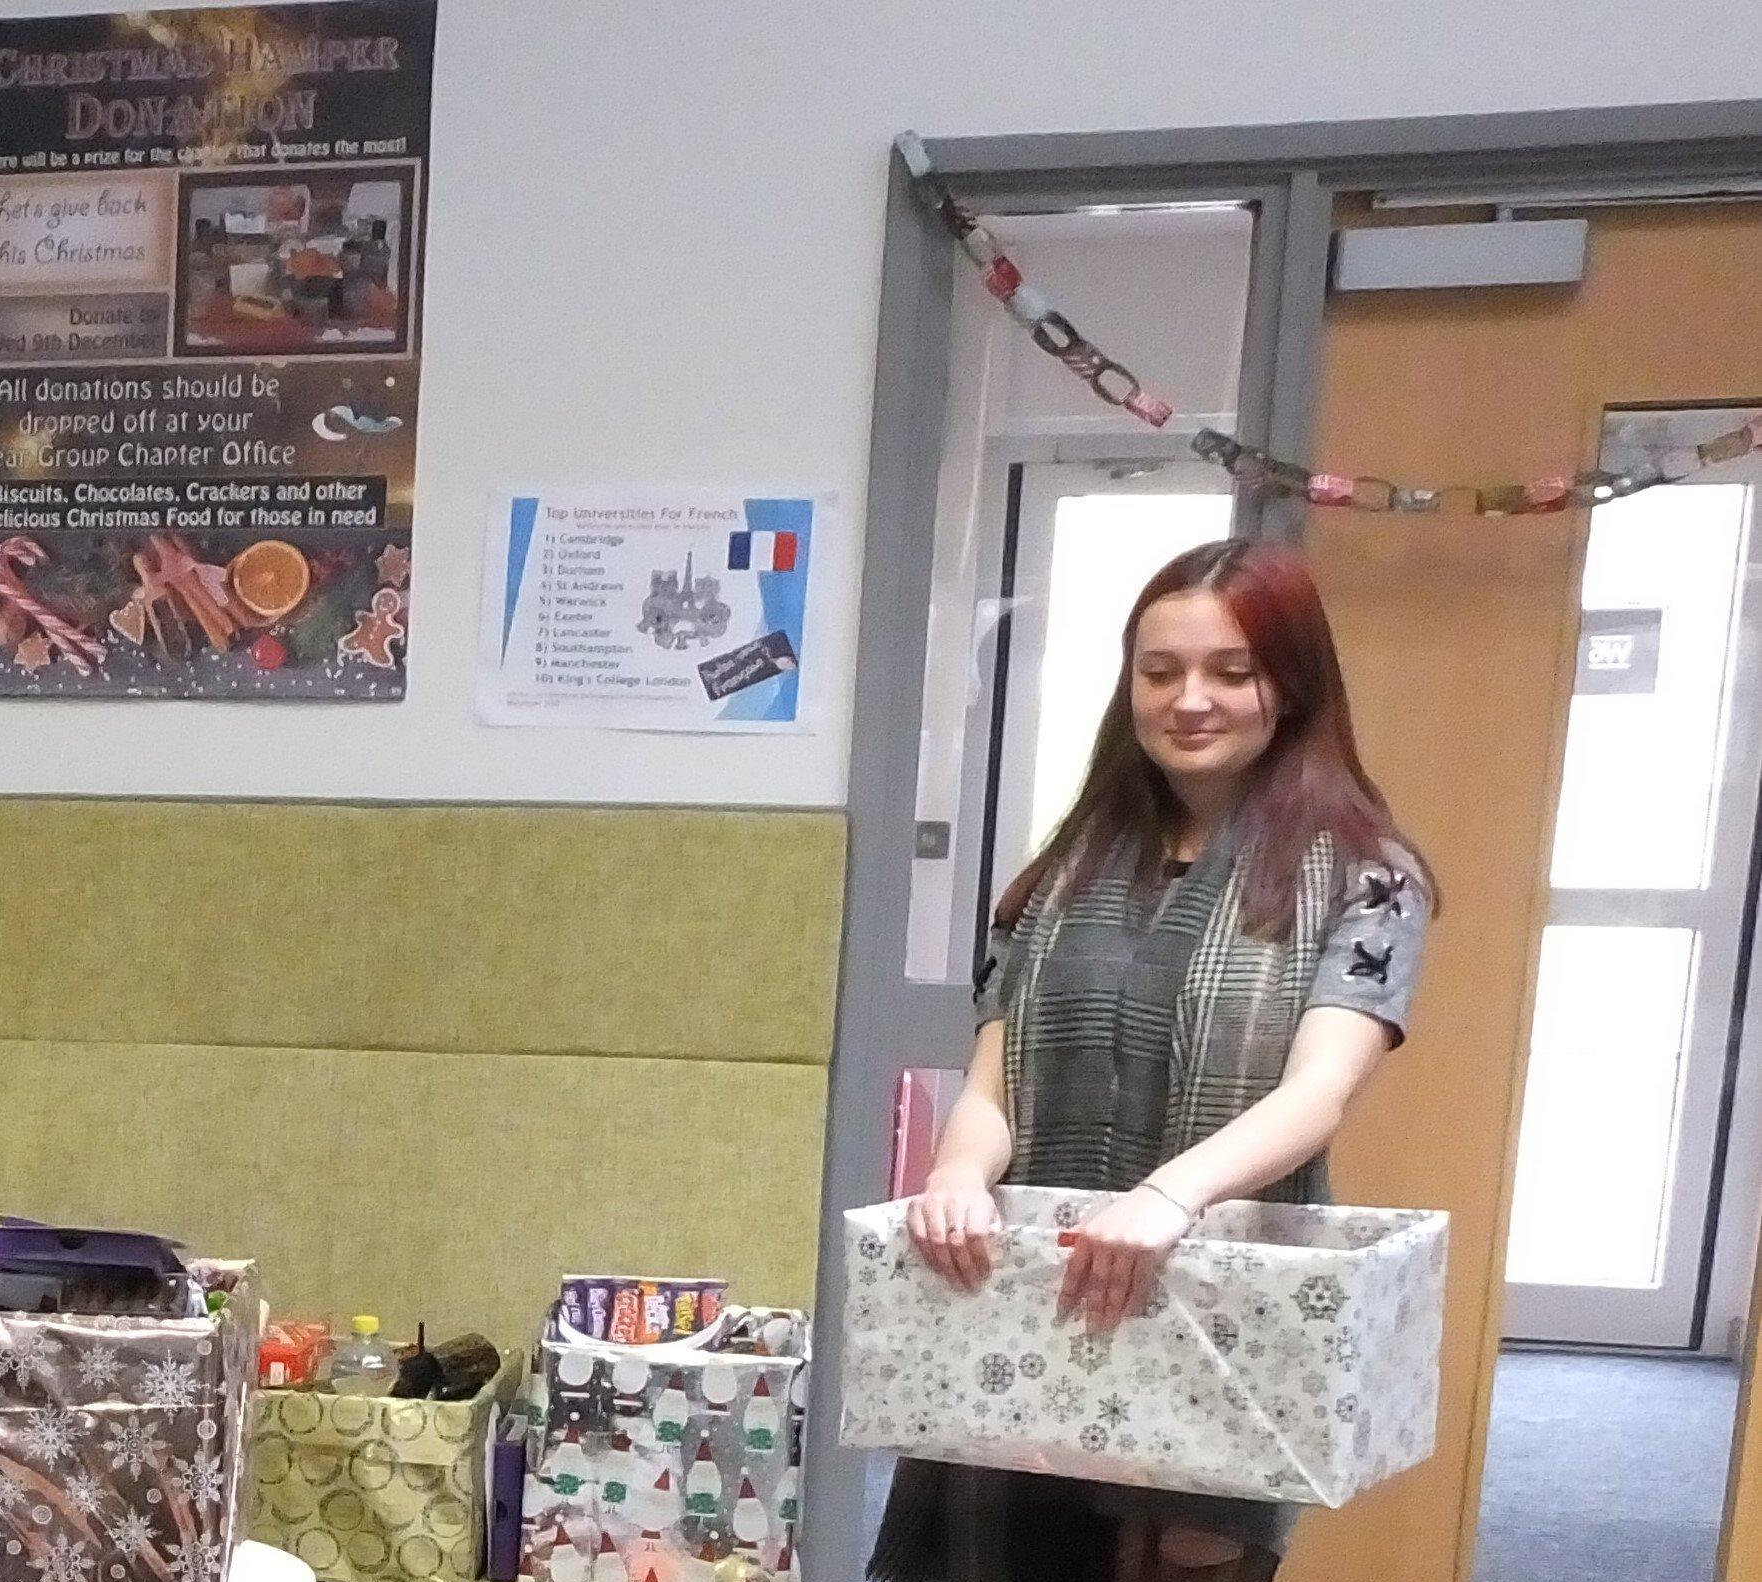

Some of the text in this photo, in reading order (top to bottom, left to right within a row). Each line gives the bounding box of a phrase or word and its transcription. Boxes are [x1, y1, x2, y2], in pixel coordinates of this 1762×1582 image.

[50, 151, 68, 167] be
[72, 154, 81, 166] a
[84, 151, 121, 167] prize
[125, 148, 146, 164] for
[150, 147, 174, 163] the
[271, 140, 331, 159] donates
[49, 197, 89, 228] give
[96, 187, 148, 216] back
[33, 232, 146, 266] Christmas
[69, 307, 133, 326] Donate
[68, 332, 161, 352] December
[35, 377, 152, 402] donations
[162, 375, 243, 400] should
[251, 373, 279, 398] be
[19, 411, 253, 438] dropped off at your
[38, 445, 110, 469] Group
[118, 443, 213, 468] Chapter
[223, 441, 297, 465] Office
[186, 481, 269, 503] Crackers
[276, 483, 310, 501] and
[316, 481, 367, 502] other
[67, 507, 160, 529] Christmas
[166, 508, 211, 527] Food
[217, 507, 244, 527] for
[250, 506, 302, 527] those
[308, 506, 326, 525] in
[332, 506, 377, 526] need
[687, 506, 738, 521] French
[558, 549, 601, 560] Oxford
